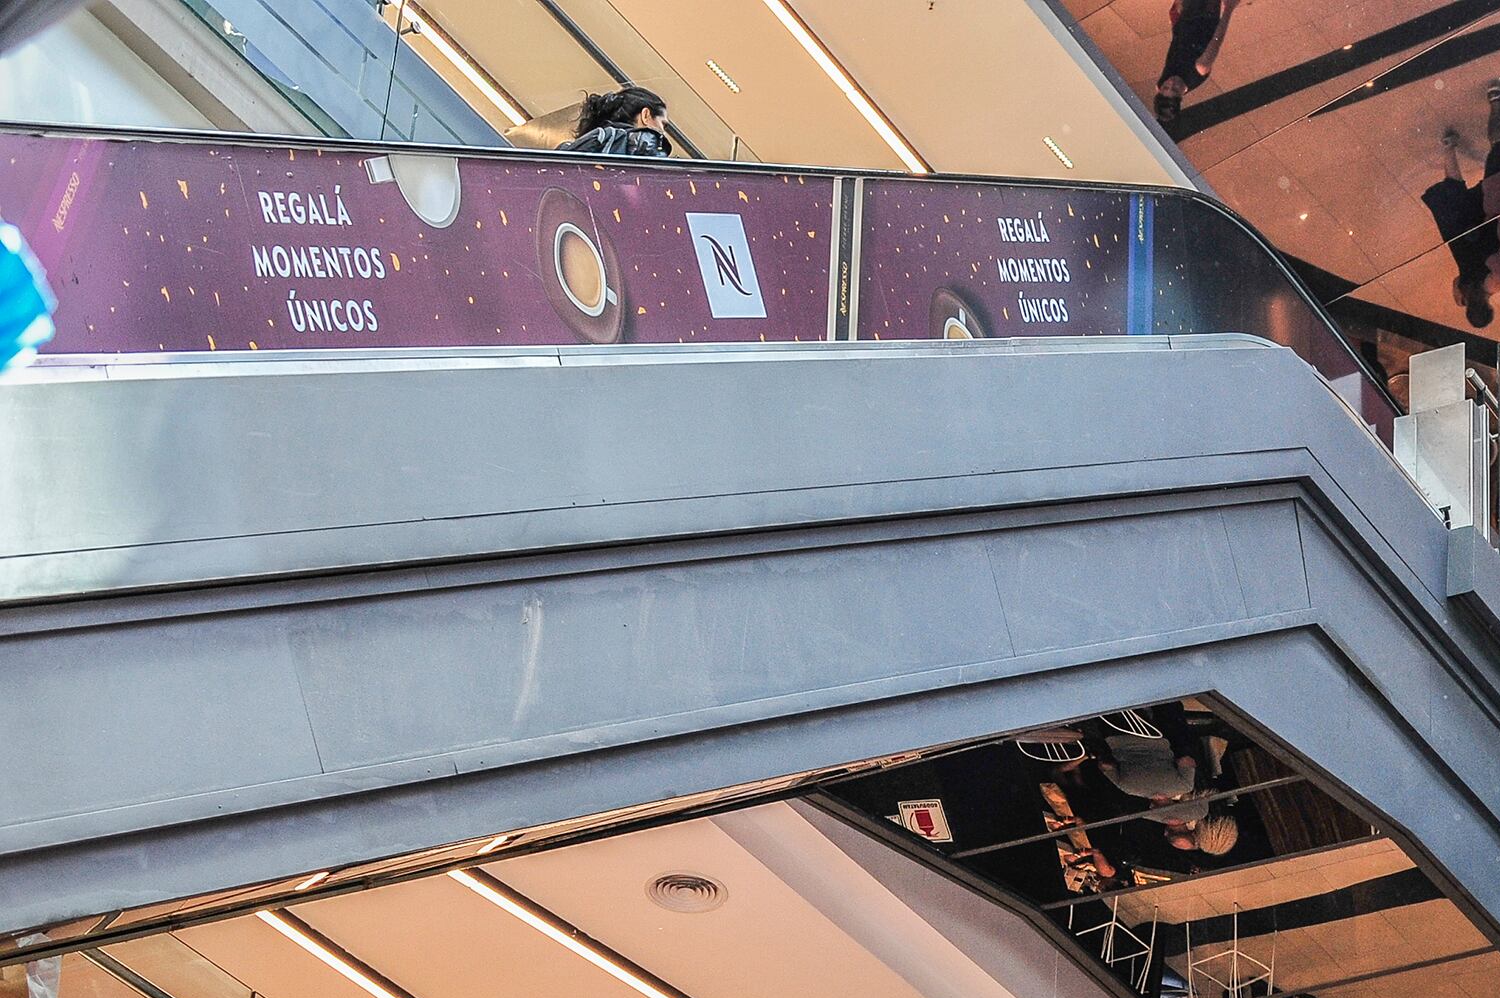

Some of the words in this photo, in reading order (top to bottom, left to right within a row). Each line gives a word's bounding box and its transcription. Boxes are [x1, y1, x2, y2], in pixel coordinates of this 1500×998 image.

[53, 172, 80, 233] NESPRESSO
[258, 184, 353, 226] REGALÁ
[997, 211, 1051, 243] REGALÁ
[251, 245, 386, 279] MOMENTOS
[996, 258, 1071, 283] MOMENTOS
[286, 289, 379, 332] ÚNICOS
[1018, 291, 1069, 322] ÚNICOS
